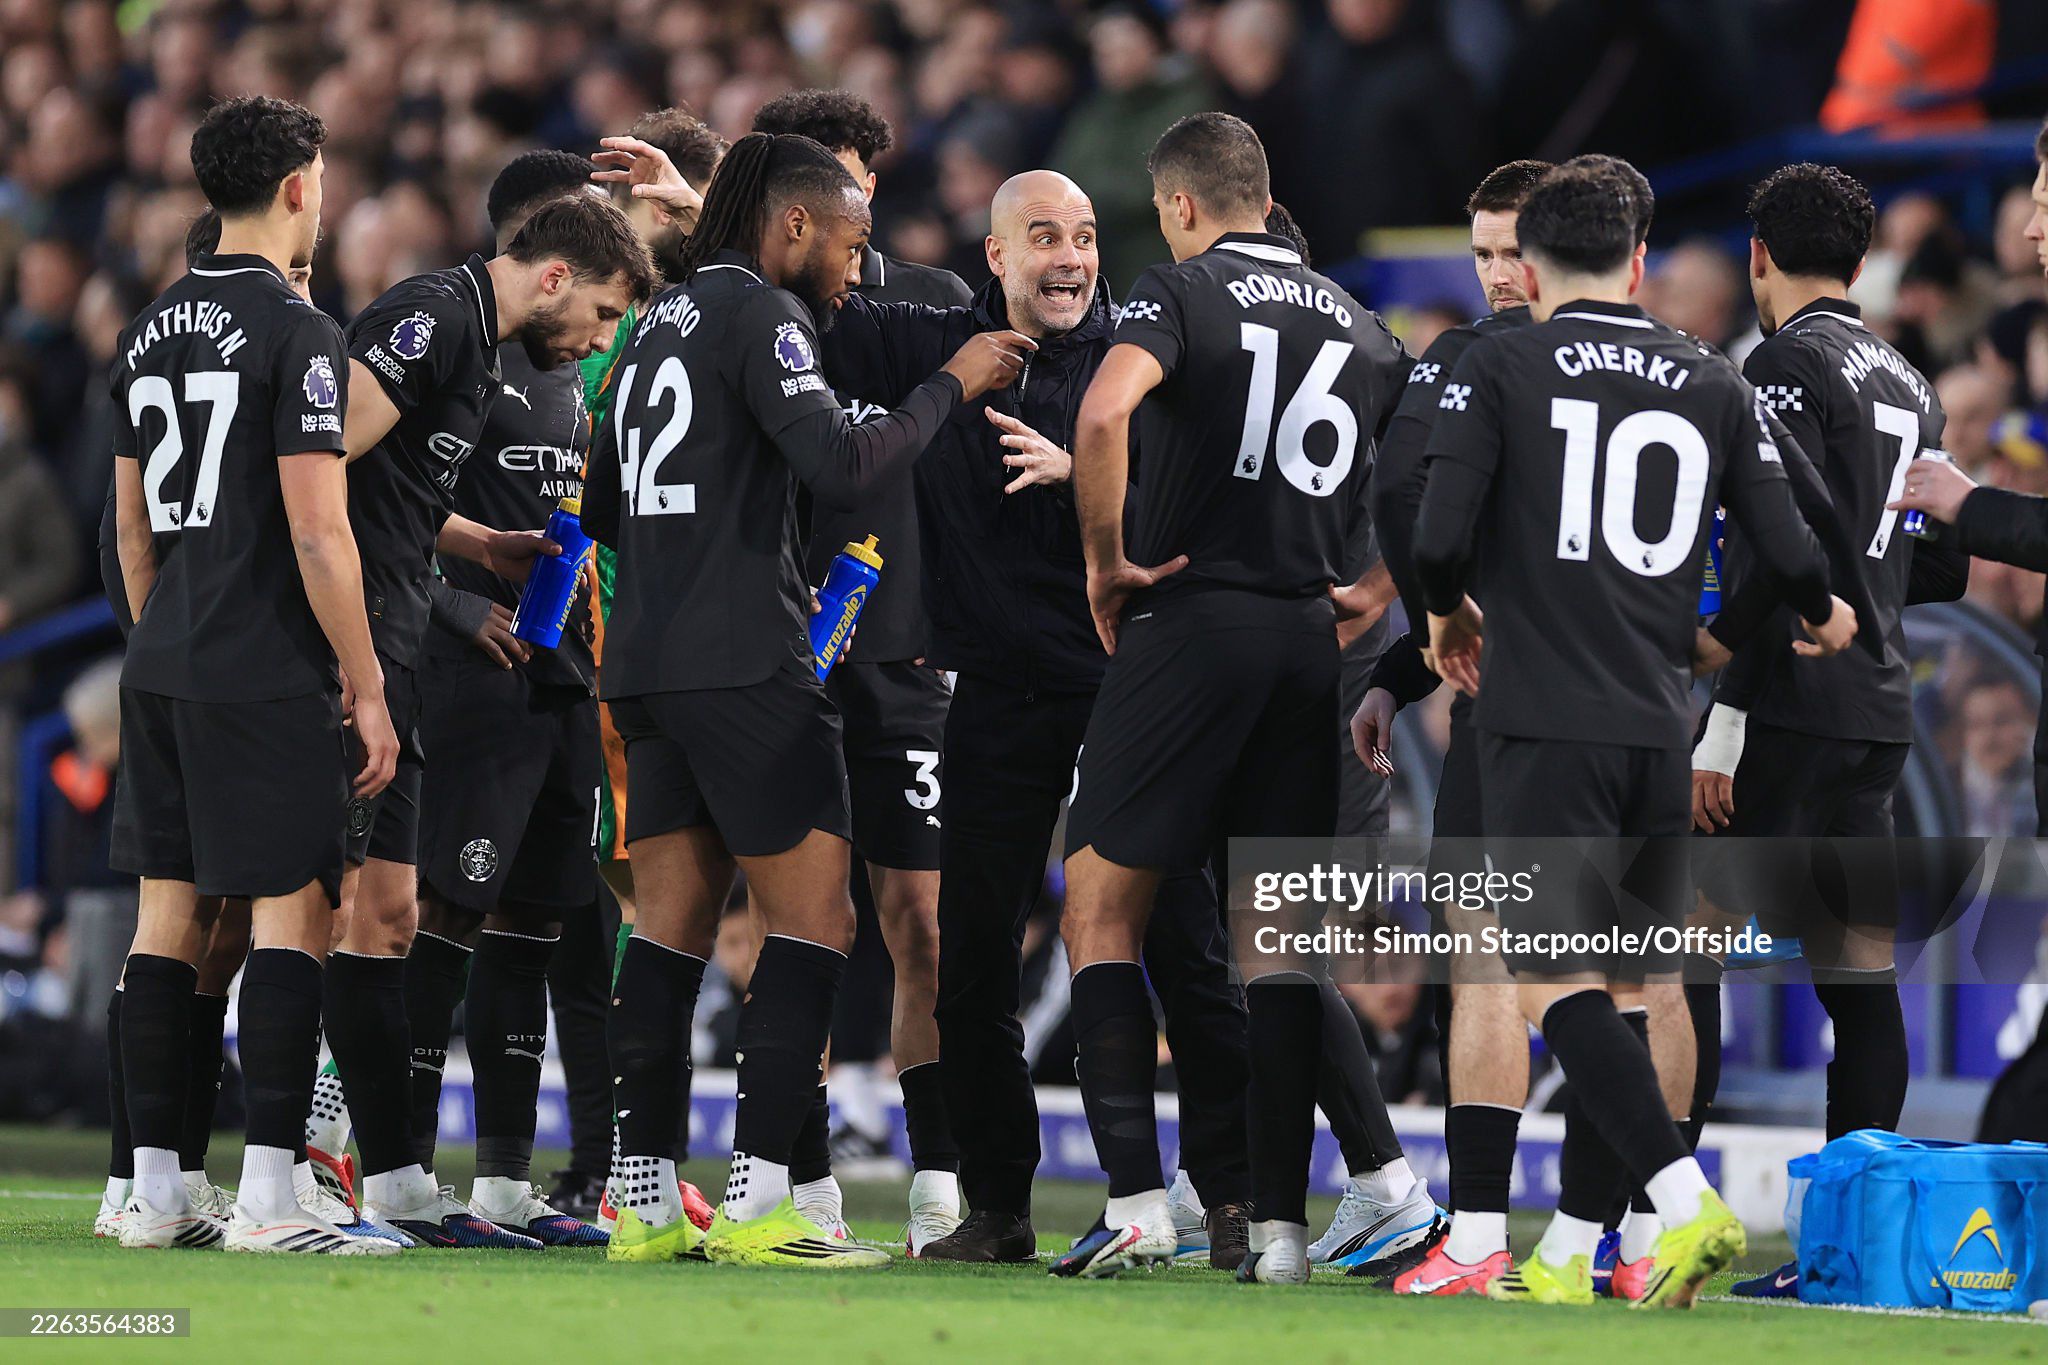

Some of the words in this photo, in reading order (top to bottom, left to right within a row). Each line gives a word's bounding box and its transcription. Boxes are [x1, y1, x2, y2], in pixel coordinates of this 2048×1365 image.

[1227, 273, 1352, 329] RODRIGO
[127, 301, 232, 372] MATHEUS
[216, 327, 248, 366] N.
[382, 356, 406, 375] room
[1555, 340, 1690, 391] CHERKI
[780, 378, 798, 389] No
[1233, 321, 1358, 497] 16
[128, 371, 239, 532] 27
[301, 414, 318, 424] No
[614, 356, 695, 516] 42
[1551, 397, 1710, 577] 10
[1866, 401, 1919, 559] 7
[816, 596, 862, 670] Lucozade
[905, 750, 941, 810] 3
[506, 1034, 546, 1042] CITY
